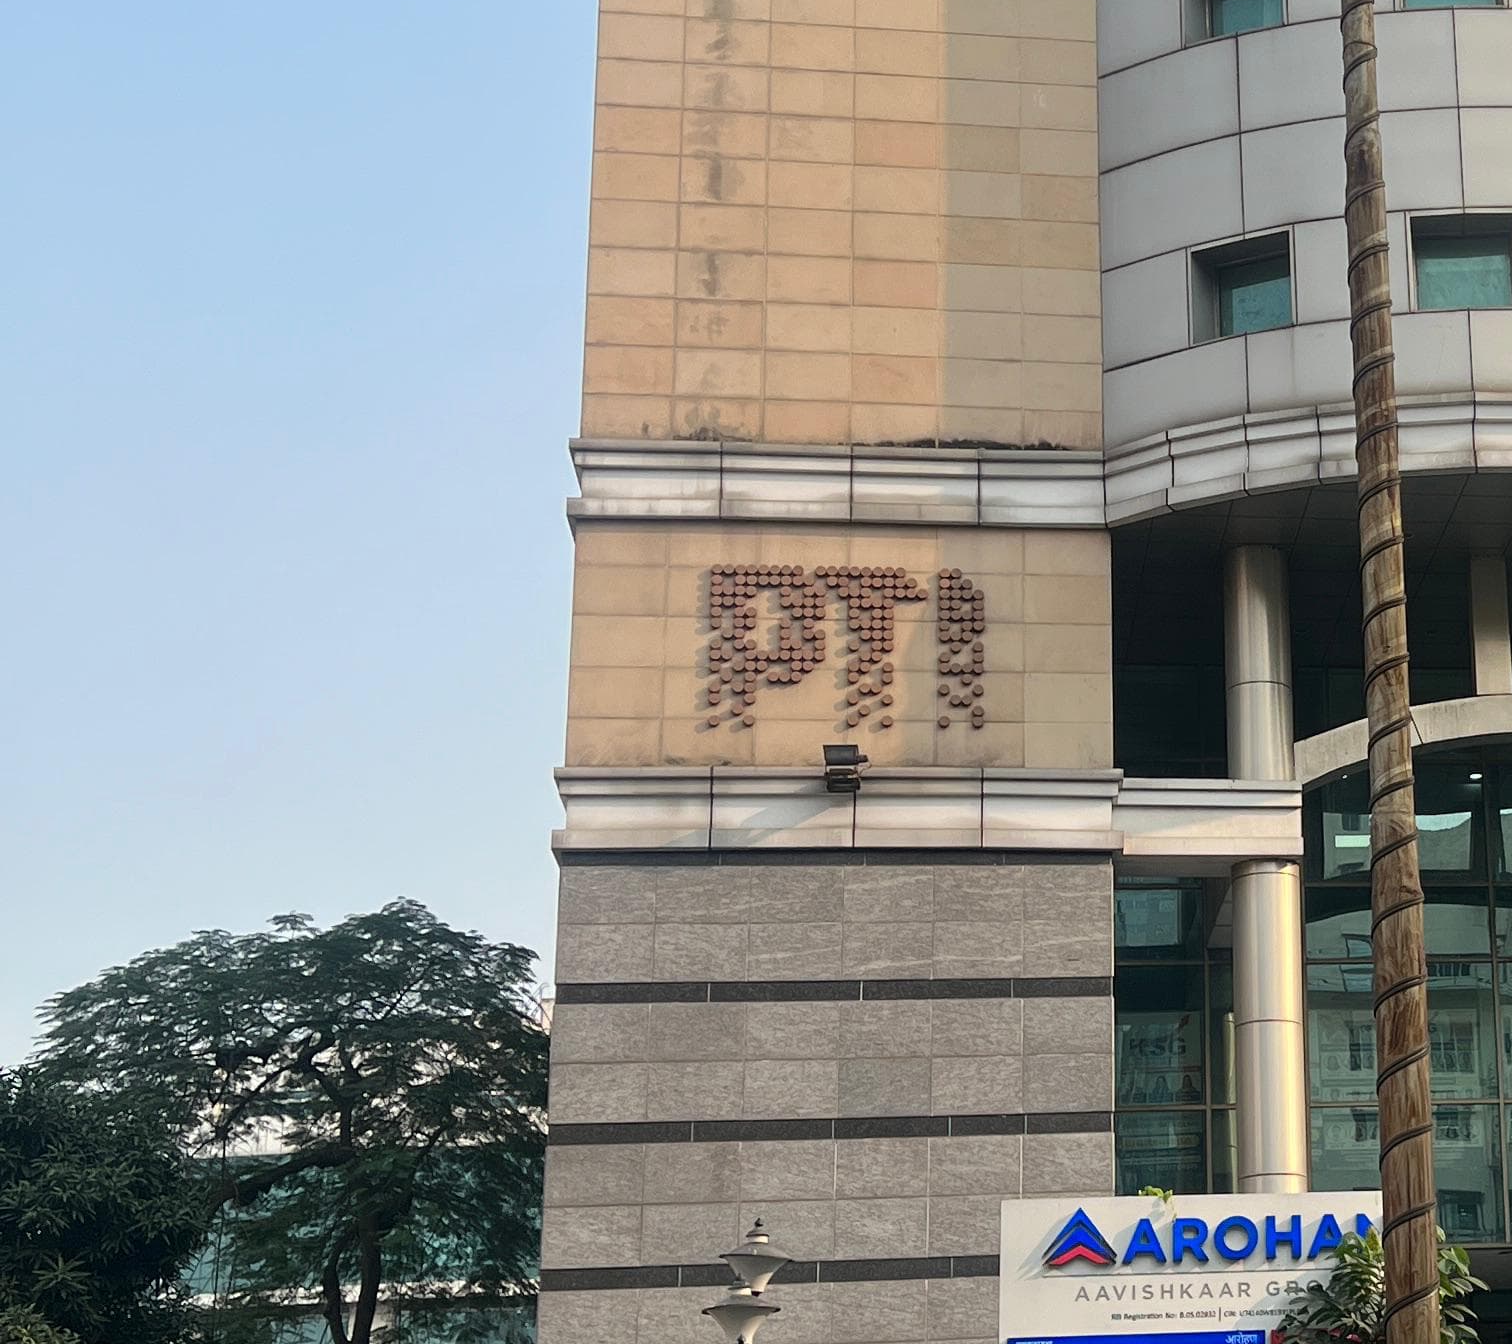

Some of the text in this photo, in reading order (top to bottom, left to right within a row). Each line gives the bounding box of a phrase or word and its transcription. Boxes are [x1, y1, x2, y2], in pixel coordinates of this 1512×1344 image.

[708, 564, 985, 729] PTI
[1074, 1279, 1326, 1302] AAVISHKAAR GRO
[1124, 1312, 1163, 1321] Registration
[1225, 1331, 1258, 1344] आरोहण
